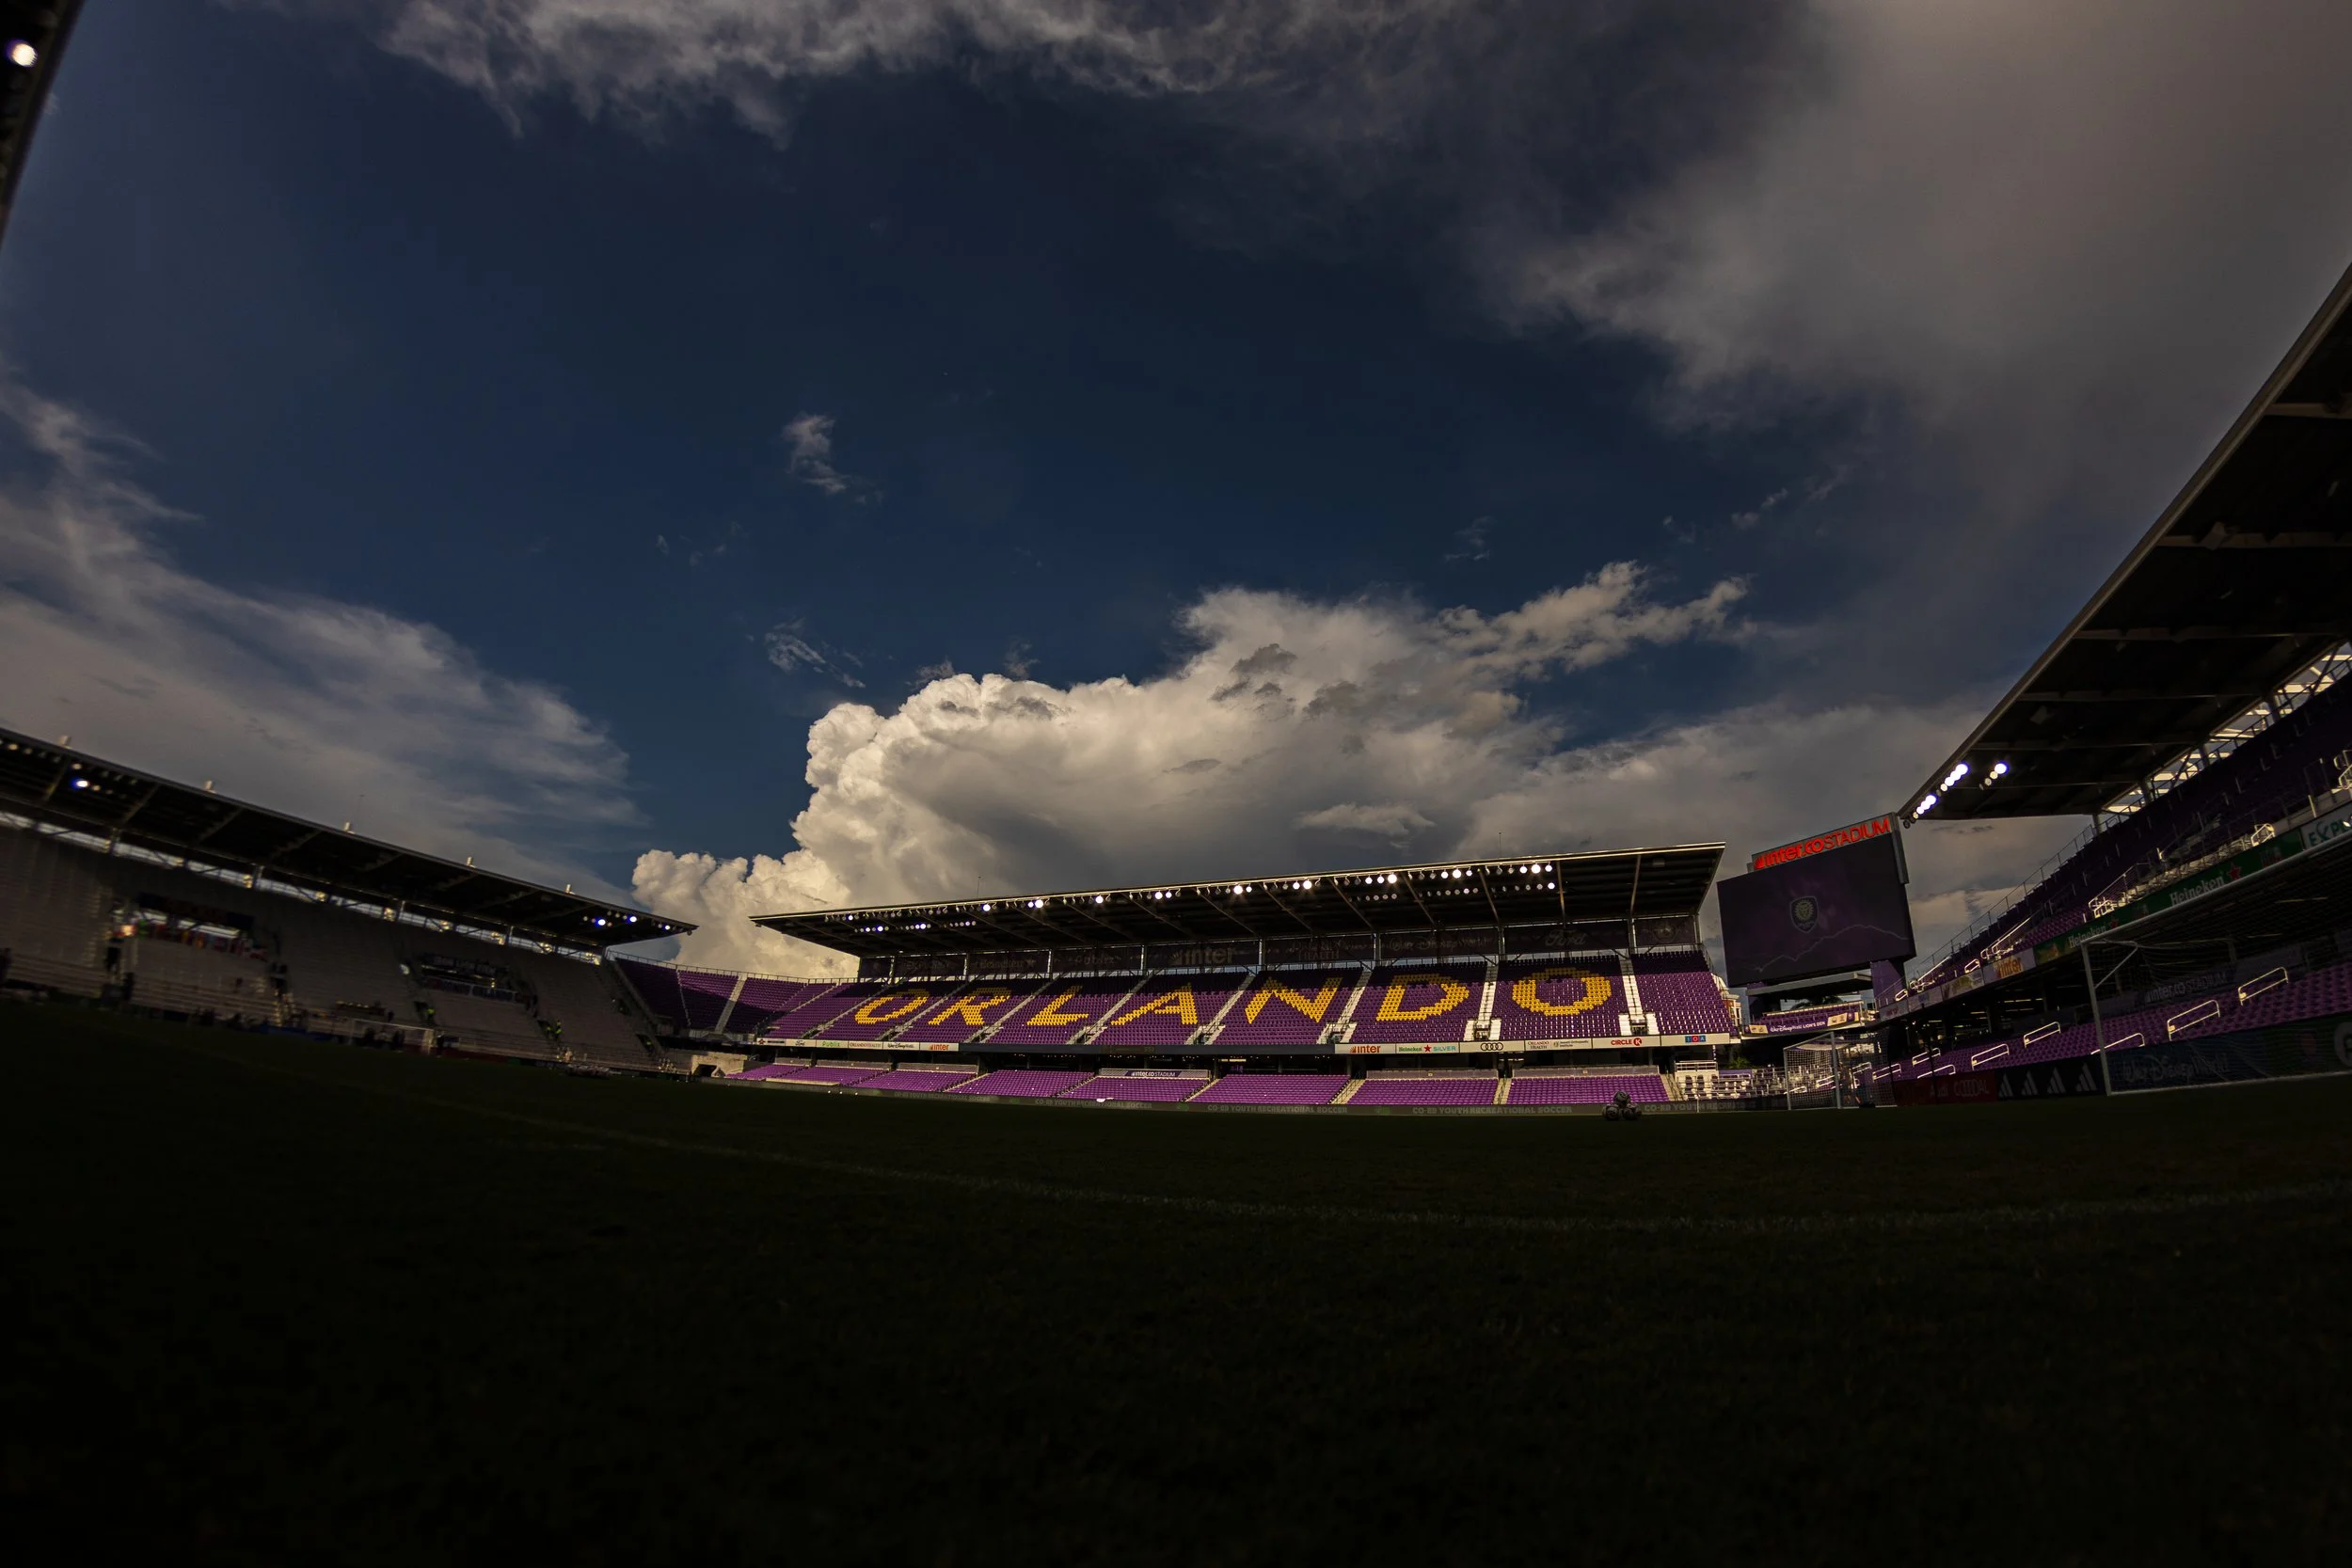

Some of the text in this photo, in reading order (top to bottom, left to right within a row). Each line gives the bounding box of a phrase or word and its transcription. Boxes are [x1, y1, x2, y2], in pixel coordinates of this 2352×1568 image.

[1824, 816, 1890, 849] STADIUM
[2169, 876, 2224, 905] Heineken
[1545, 928, 1587, 947] Ford
[1184, 945, 1236, 965] inter
[853, 966, 1613, 1026] ORLANDO
[1357, 1045, 1381, 1053] inter
[1470, 1106, 1536, 1115] RECREATIONAL
[1537, 1105, 1572, 1114] SOCCER
[1673, 1103, 1703, 1112] YOUTH
